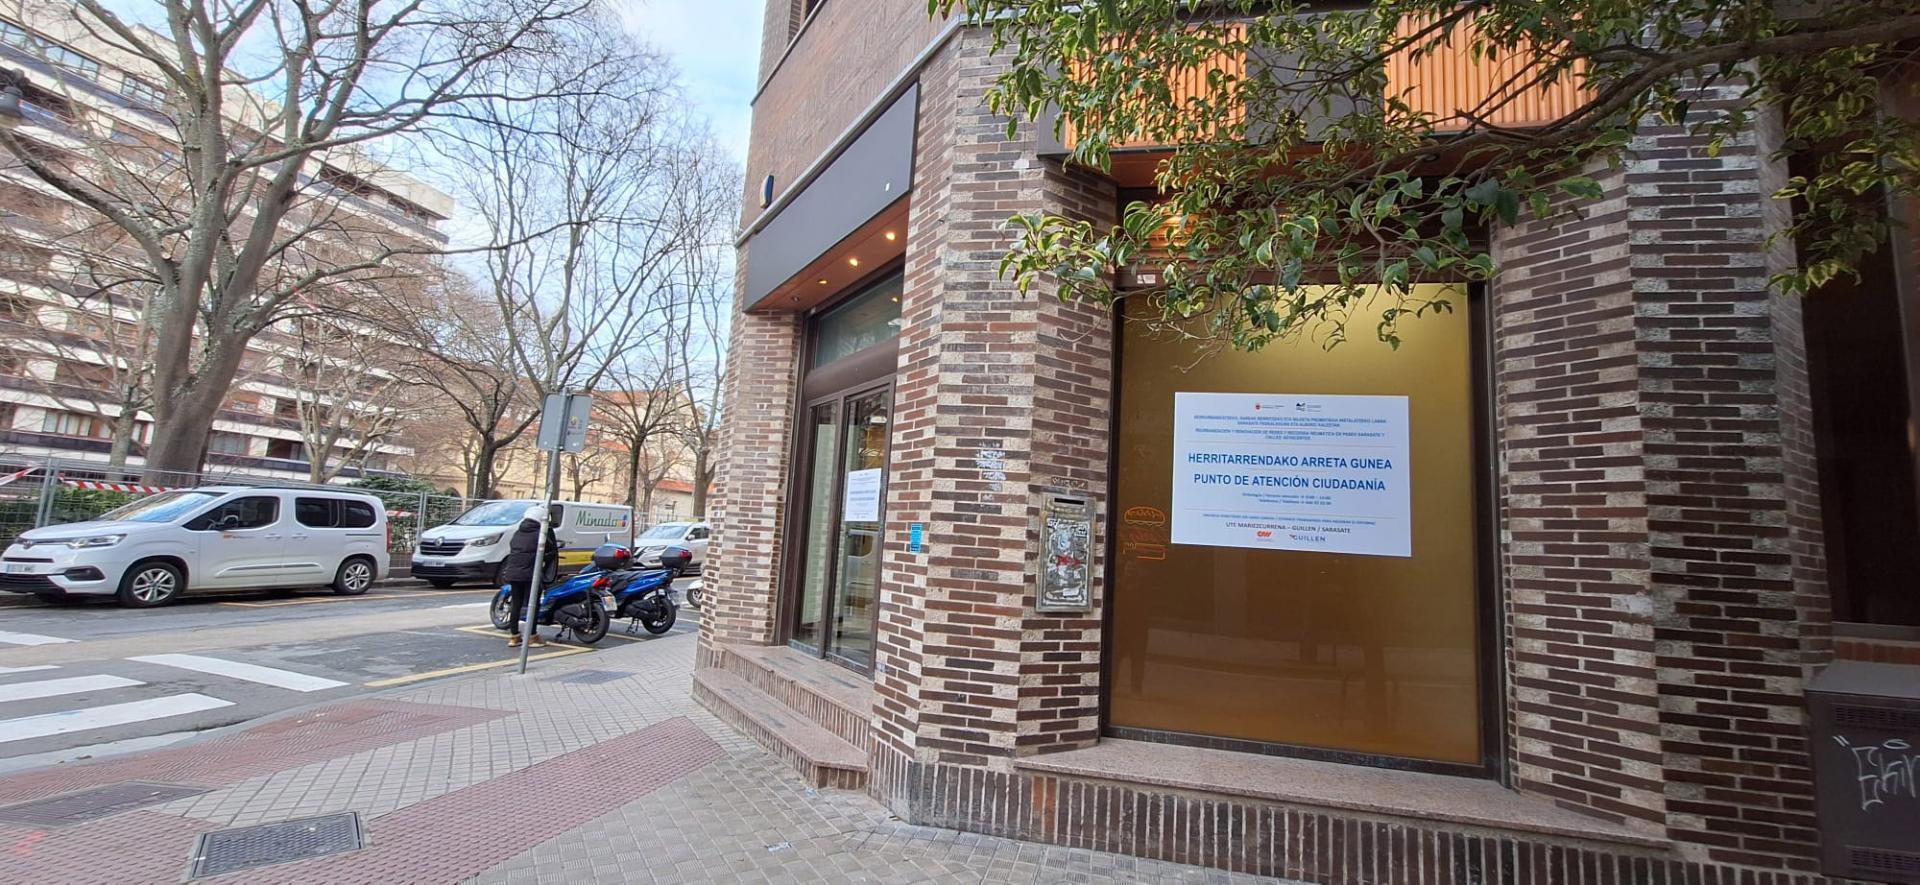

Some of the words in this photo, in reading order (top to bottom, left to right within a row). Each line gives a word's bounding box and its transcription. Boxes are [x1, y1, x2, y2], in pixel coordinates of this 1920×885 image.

[1188, 453, 1298, 466] HERRITARRENDAKO
[1301, 457, 1347, 468] ARRETA
[1350, 458, 1393, 470] GUNEA
[1194, 473, 1231, 485] PUNTO
[1234, 475, 1249, 486] DE
[1252, 475, 1309, 488] ATENCIÓN
[1312, 478, 1386, 490] CIUDADANÍA
